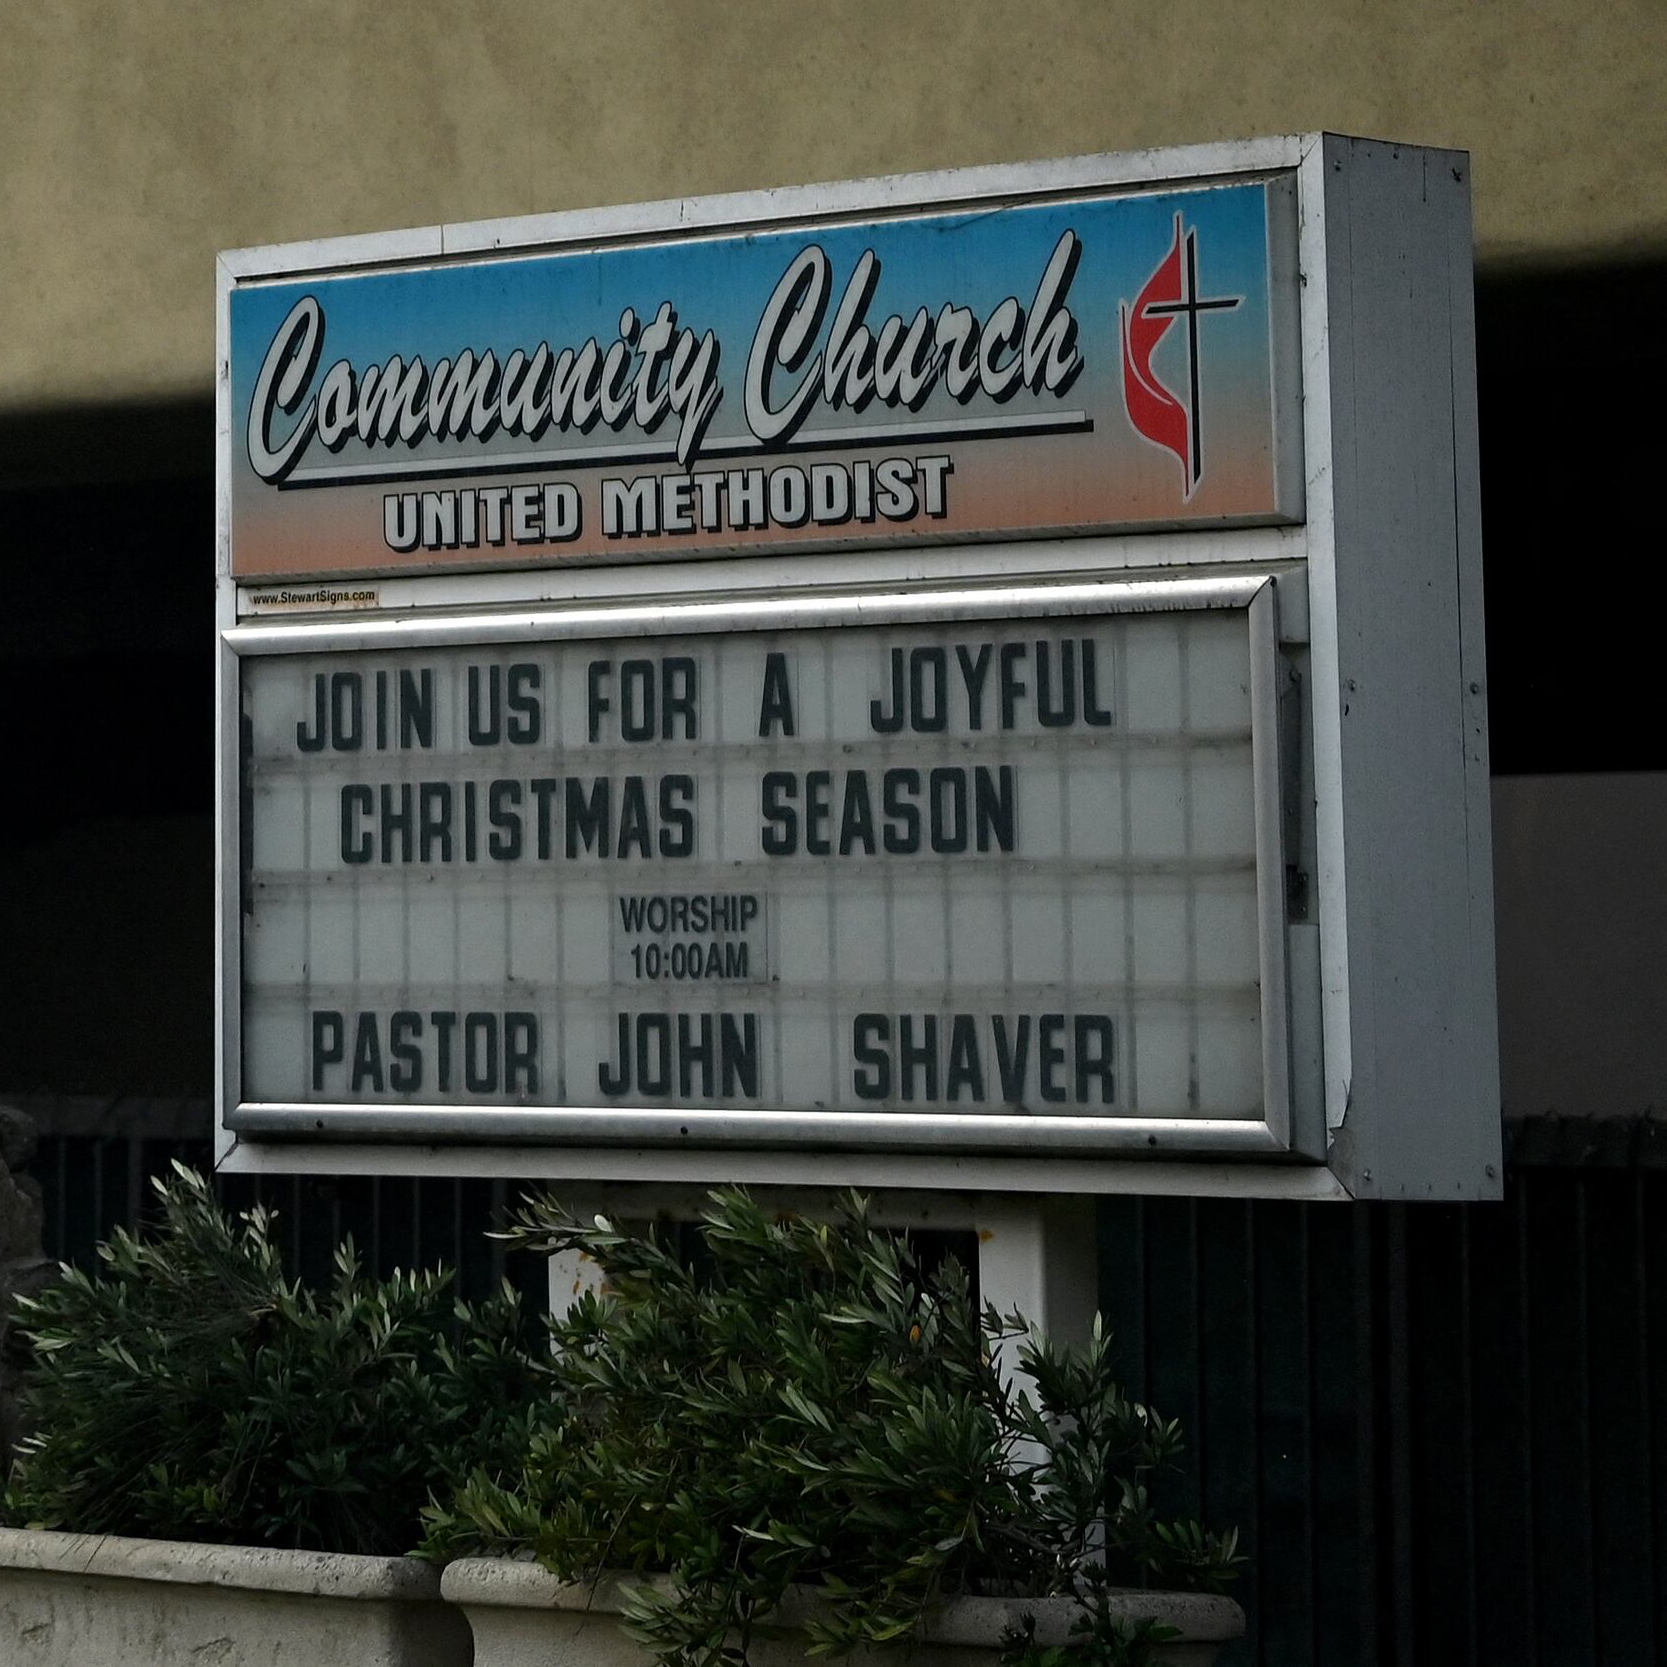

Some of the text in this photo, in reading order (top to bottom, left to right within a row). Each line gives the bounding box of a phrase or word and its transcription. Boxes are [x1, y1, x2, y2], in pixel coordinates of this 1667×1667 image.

[247, 228, 1084, 484] Community Church
[383, 455, 953, 552] UNITED METHODIST
[253, 590, 375, 605] www.StewartSigns.com
[296, 639, 1112, 751] JOIN US FOR A JOYFUL
[341, 765, 1014, 863] CHRISTMAS SEASON
[619, 895, 758, 933] WORSHIP
[630, 942, 749, 979] 10:00AM
[312, 1011, 1115, 1104] PASTOR JOHN SHAVER
